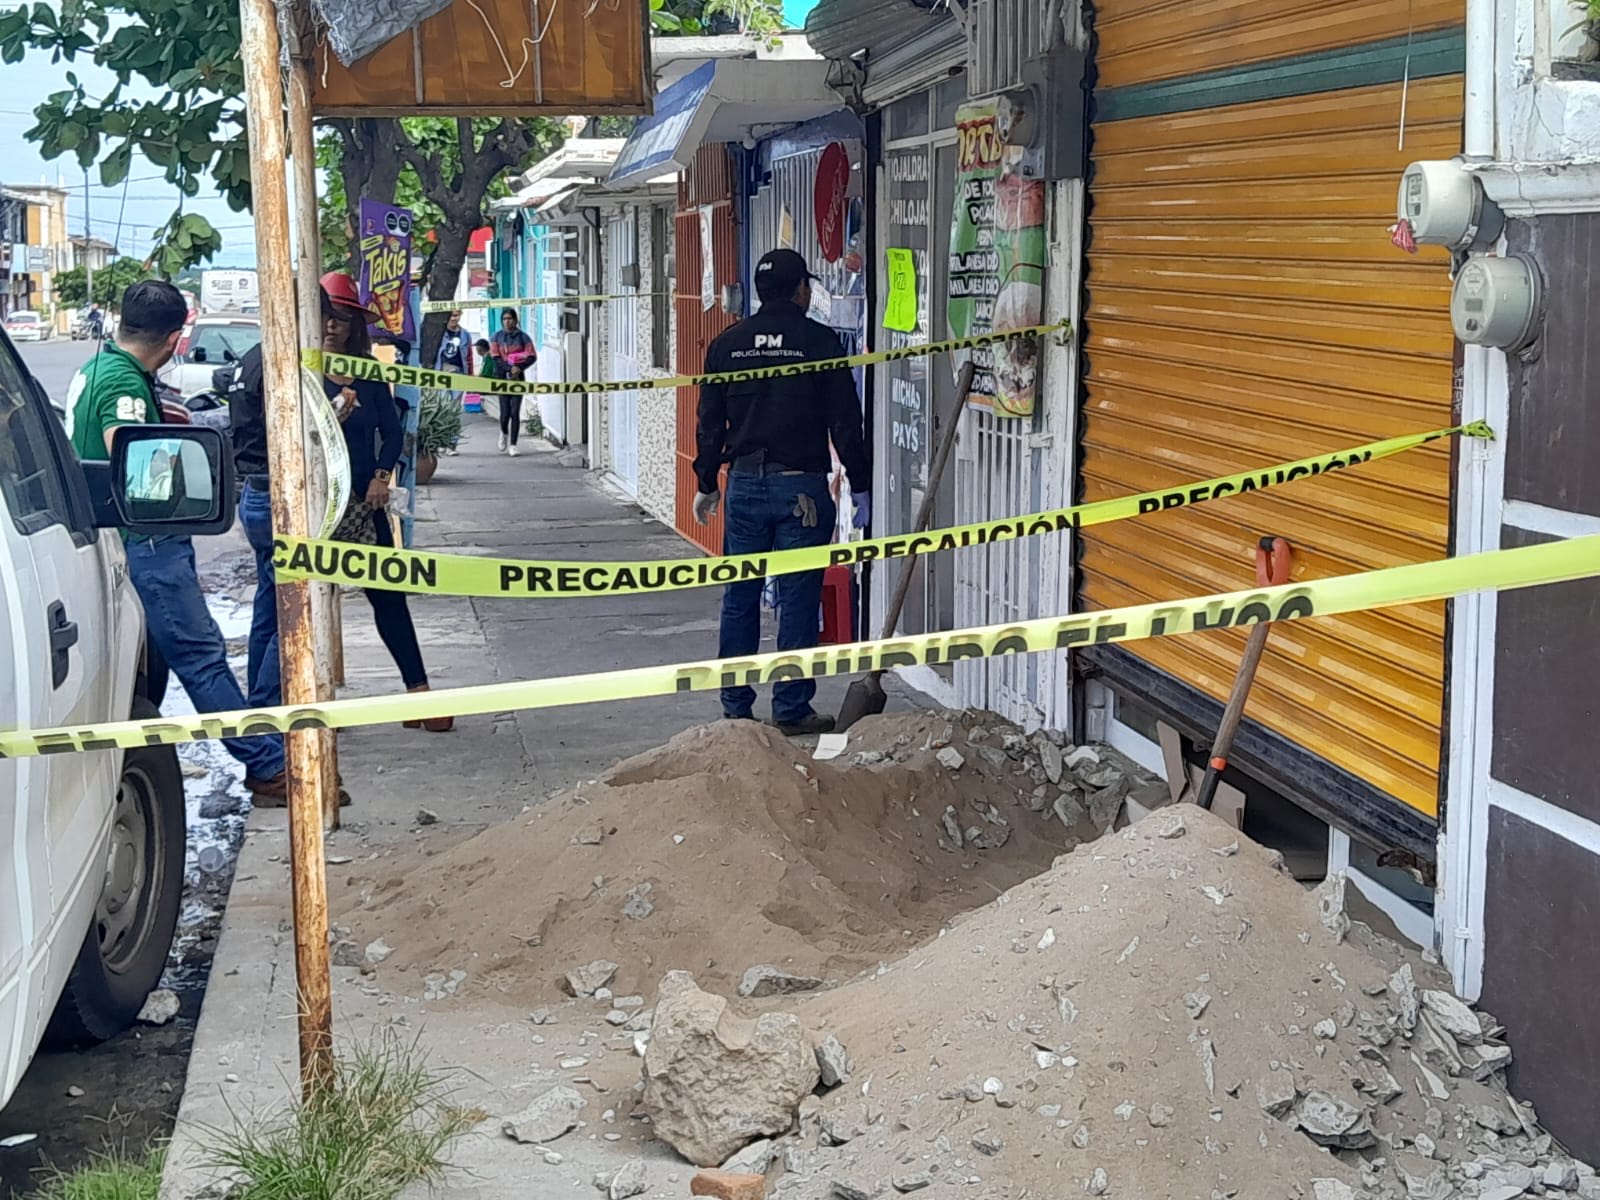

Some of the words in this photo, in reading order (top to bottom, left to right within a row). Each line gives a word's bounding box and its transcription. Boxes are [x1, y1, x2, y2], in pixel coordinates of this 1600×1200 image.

[891, 155, 929, 181] OJALDRA
[366, 247, 407, 292] Takis
[731, 349, 761, 358] POLICÍA
[761, 350, 805, 358] MINISTERIAL
[754, 334, 783, 348] PM
[892, 421, 919, 452] PAYS
[500, 556, 768, 592] PRECAUCIÓN
